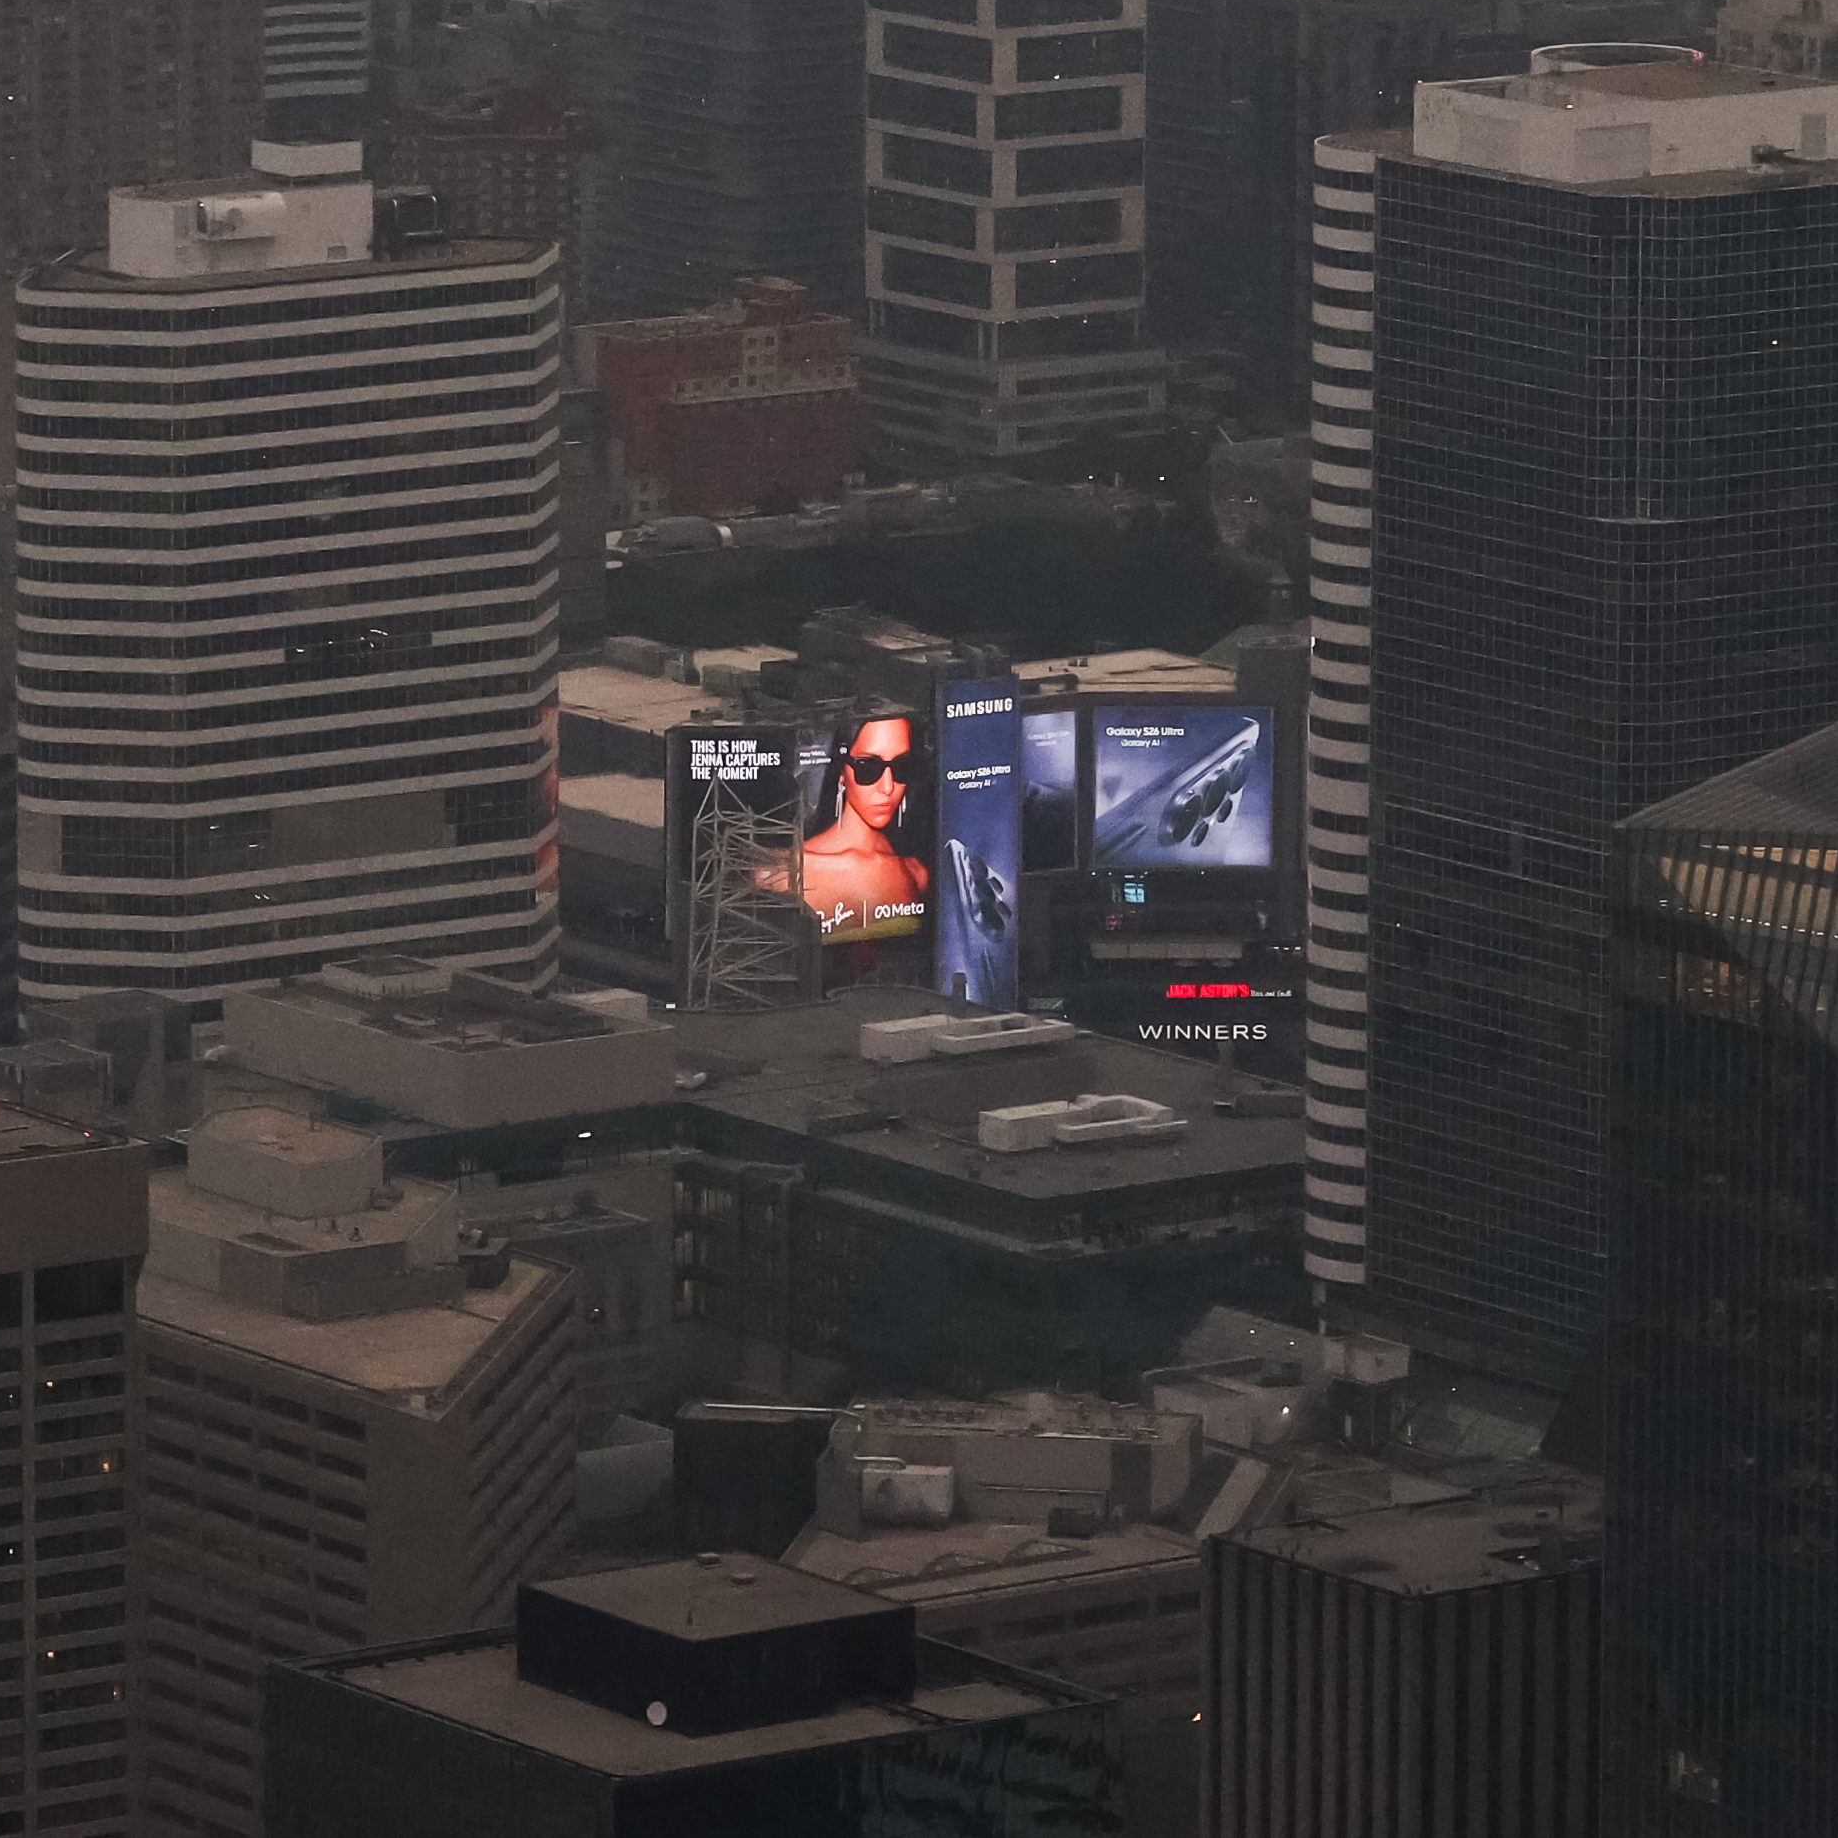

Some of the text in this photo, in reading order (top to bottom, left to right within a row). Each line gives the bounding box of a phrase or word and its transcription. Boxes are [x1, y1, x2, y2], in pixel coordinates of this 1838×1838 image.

[946, 697, 1013, 718] SAMSUNG
[1105, 726, 1185, 738] Galaxy S26 Ultra
[690, 740, 757, 754] THIS IS HOW
[690, 753, 780, 767] JENNA CAPTURES
[691, 767, 712, 780] THE
[946, 765, 1011, 781] Galaxy S26 Ultra
[891, 902, 925, 917] Meta
[1138, 1023, 1269, 1041] WINNERS
